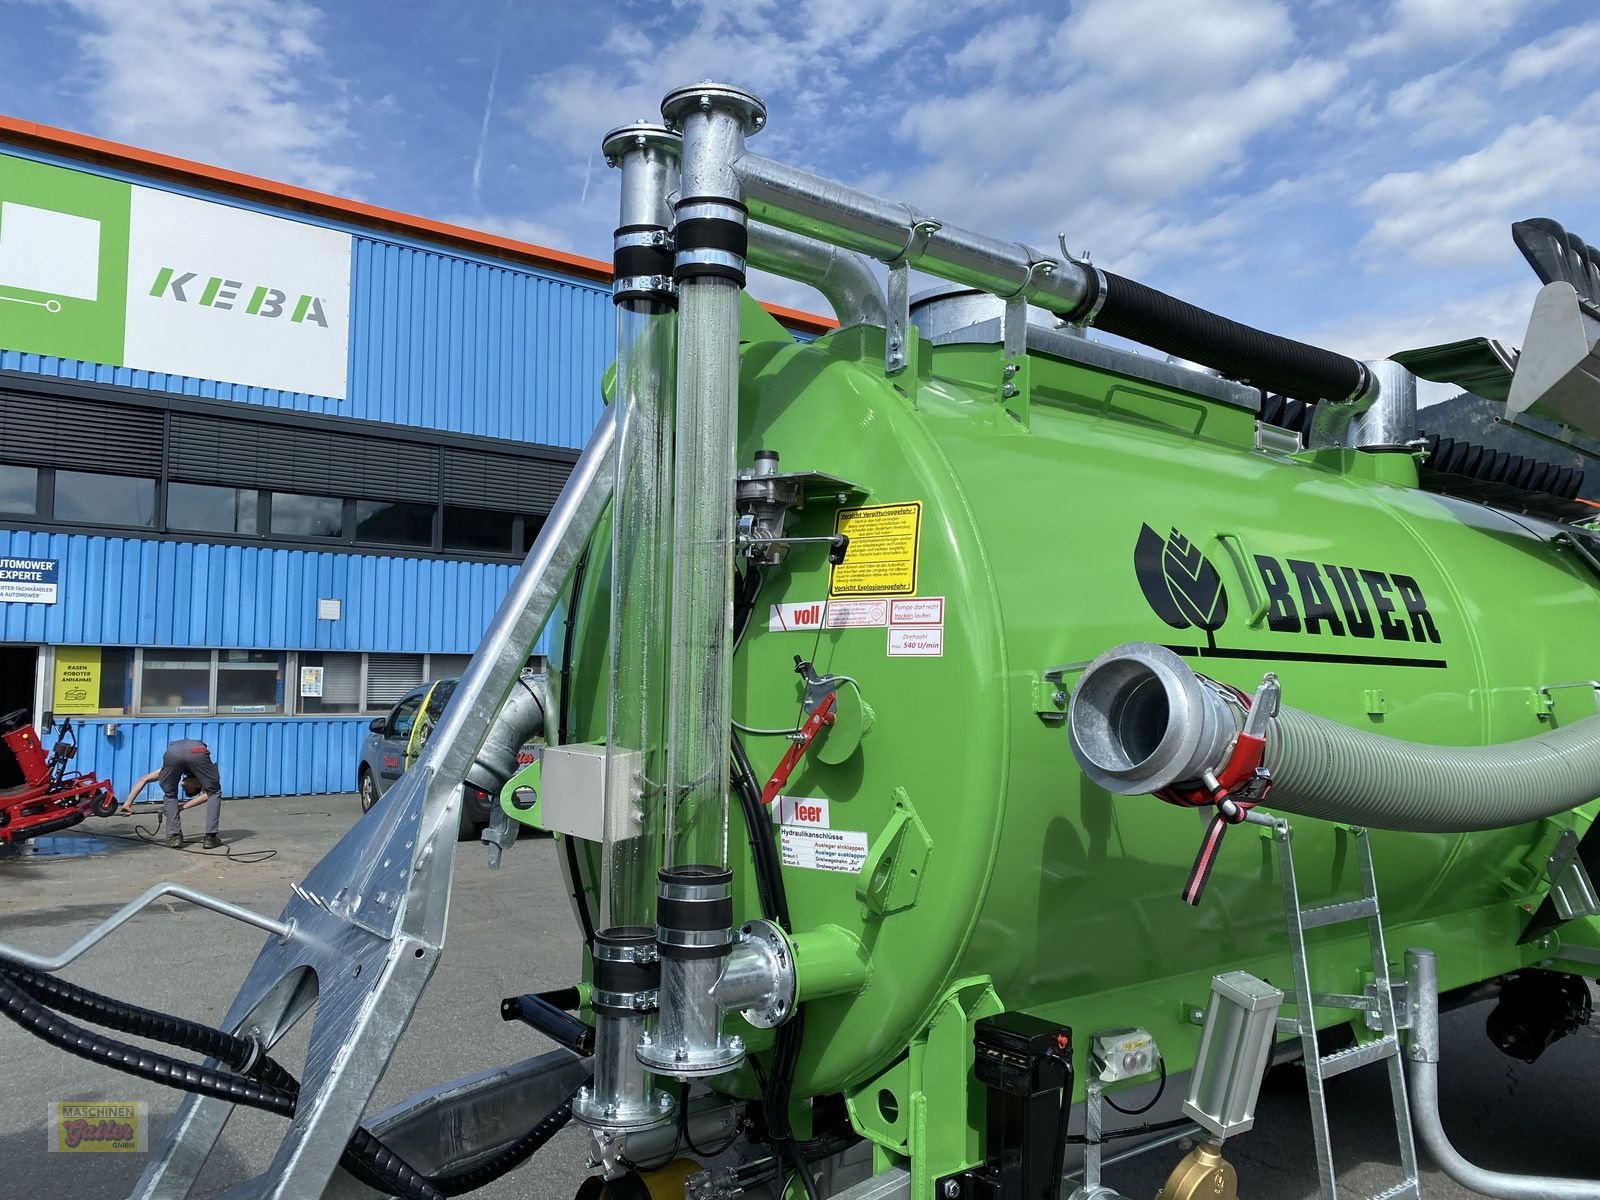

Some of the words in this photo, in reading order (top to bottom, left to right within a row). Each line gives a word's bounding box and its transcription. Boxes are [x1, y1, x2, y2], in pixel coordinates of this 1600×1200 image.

[149, 267, 328, 328] KEBA
[857, 582, 907, 591] Explosionsgefahr
[1253, 554, 1442, 644] BAUER
[794, 606, 820, 625] voll
[918, 641, 939, 650] U/min
[794, 802, 822, 822] leer
[782, 829, 844, 840] Hydraulikanschlüsse
